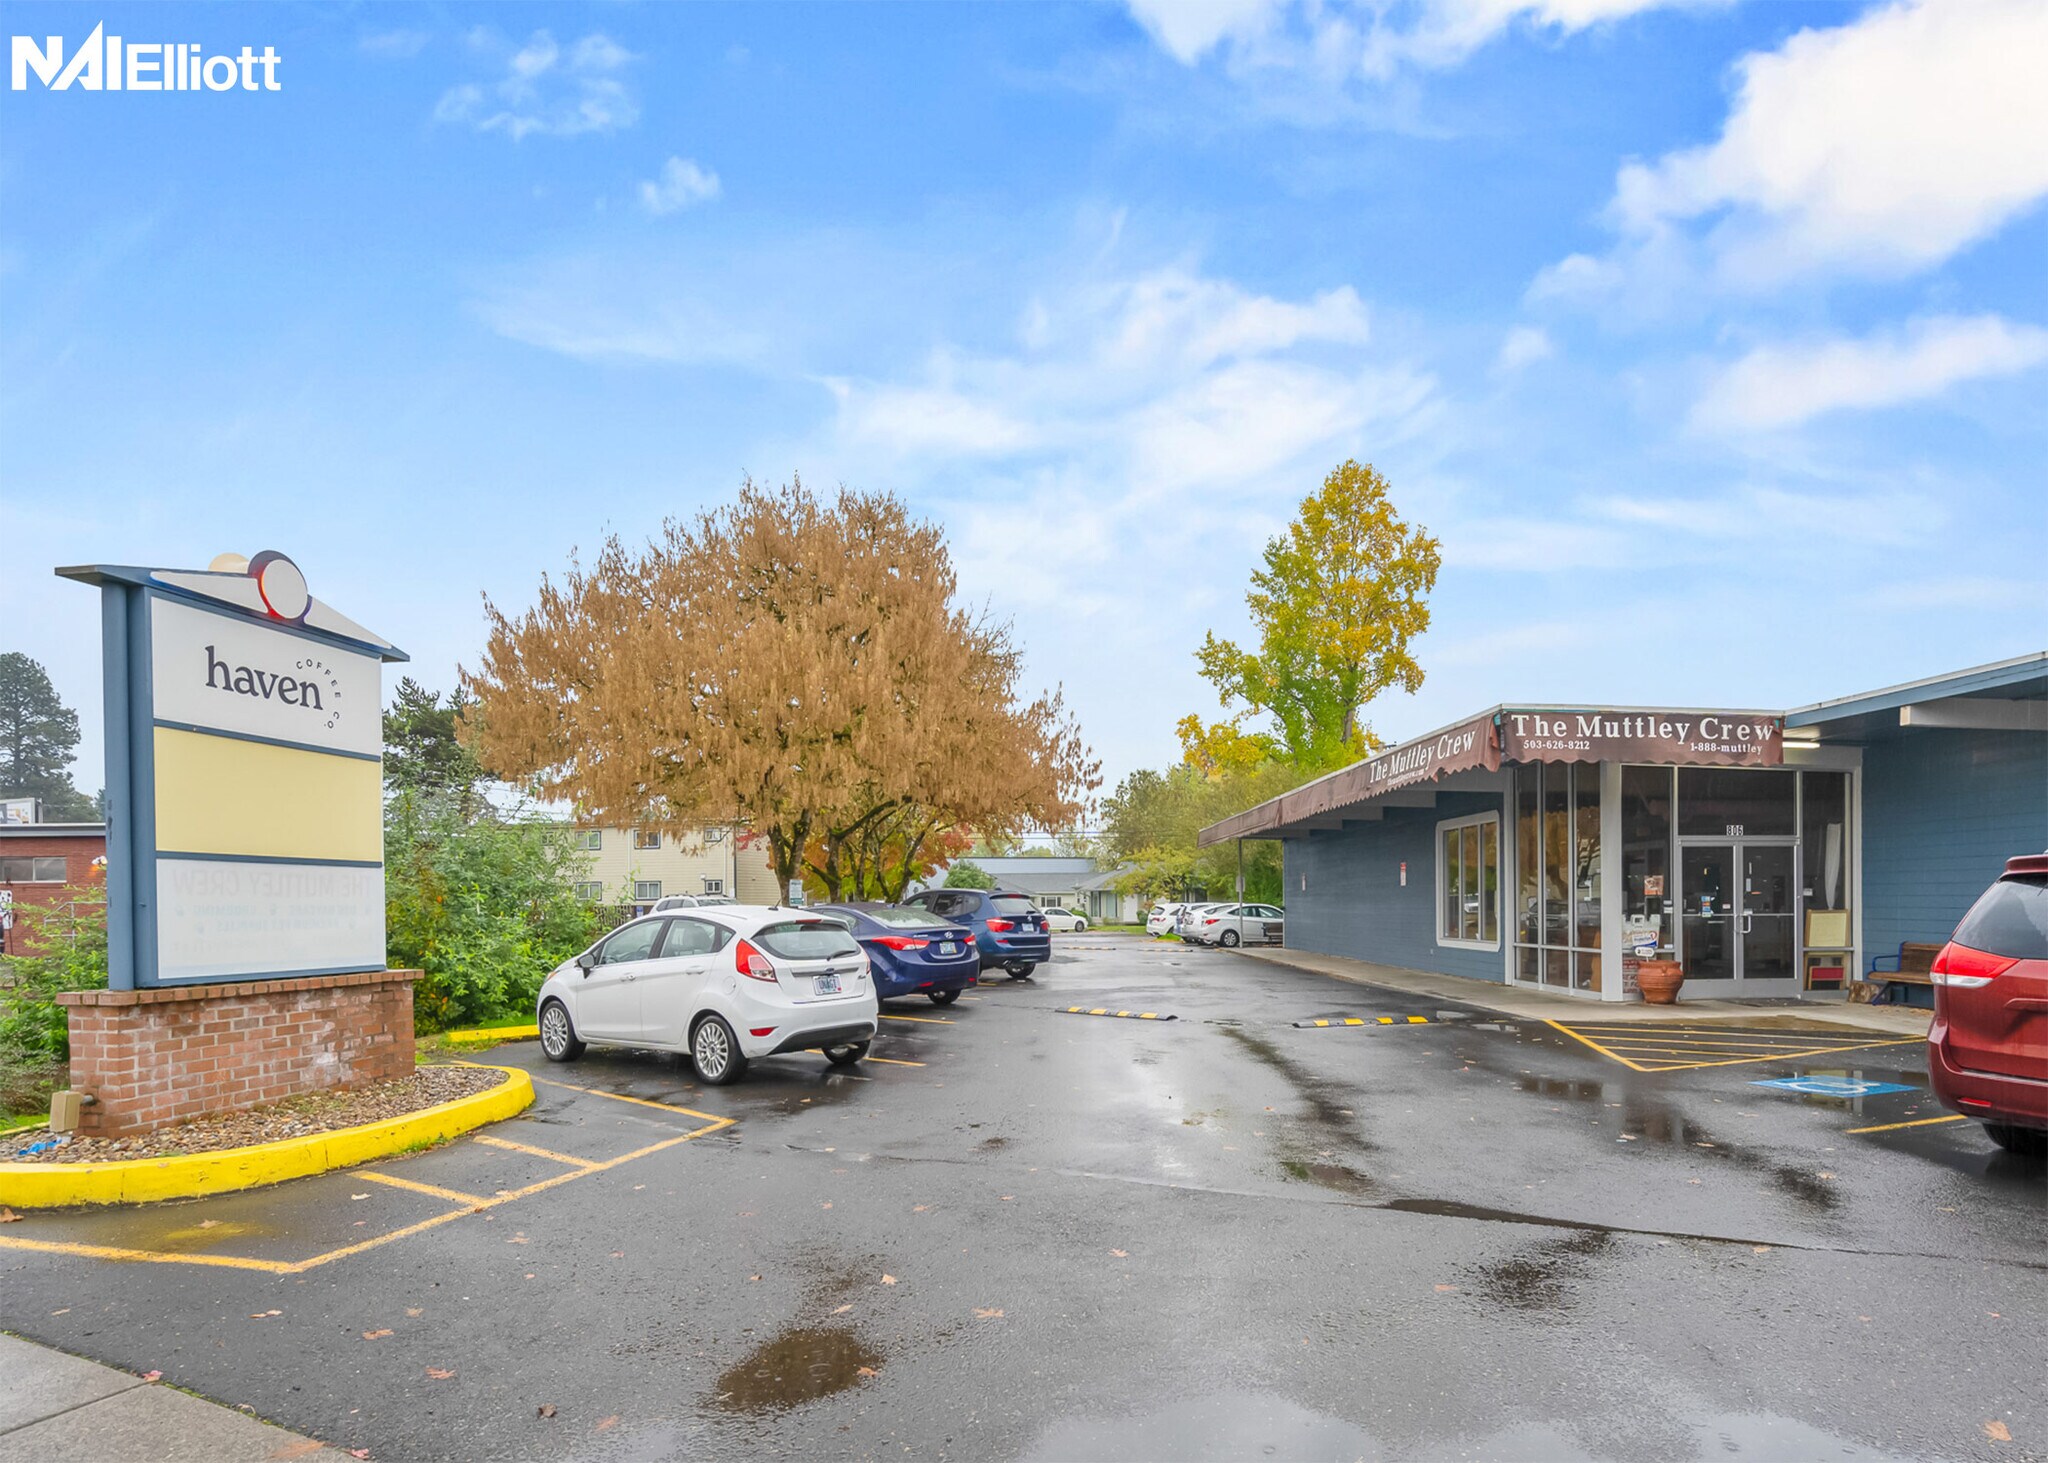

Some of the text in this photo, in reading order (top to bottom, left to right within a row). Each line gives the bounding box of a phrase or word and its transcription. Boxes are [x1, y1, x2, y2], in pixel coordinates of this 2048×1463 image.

[205, 645, 324, 711] haven
[296, 660, 342, 698] COFFEE
[1511, 714, 1774, 744] The Muttley Crew
[1523, 739, 1590, 750] 503-626-8212
[1369, 761, 1388, 784] The
[1388, 744, 1436, 777] Muttley
[1437, 729, 1475, 760] Crew
[1690, 742, 1763, 755] 1-888-muttley
